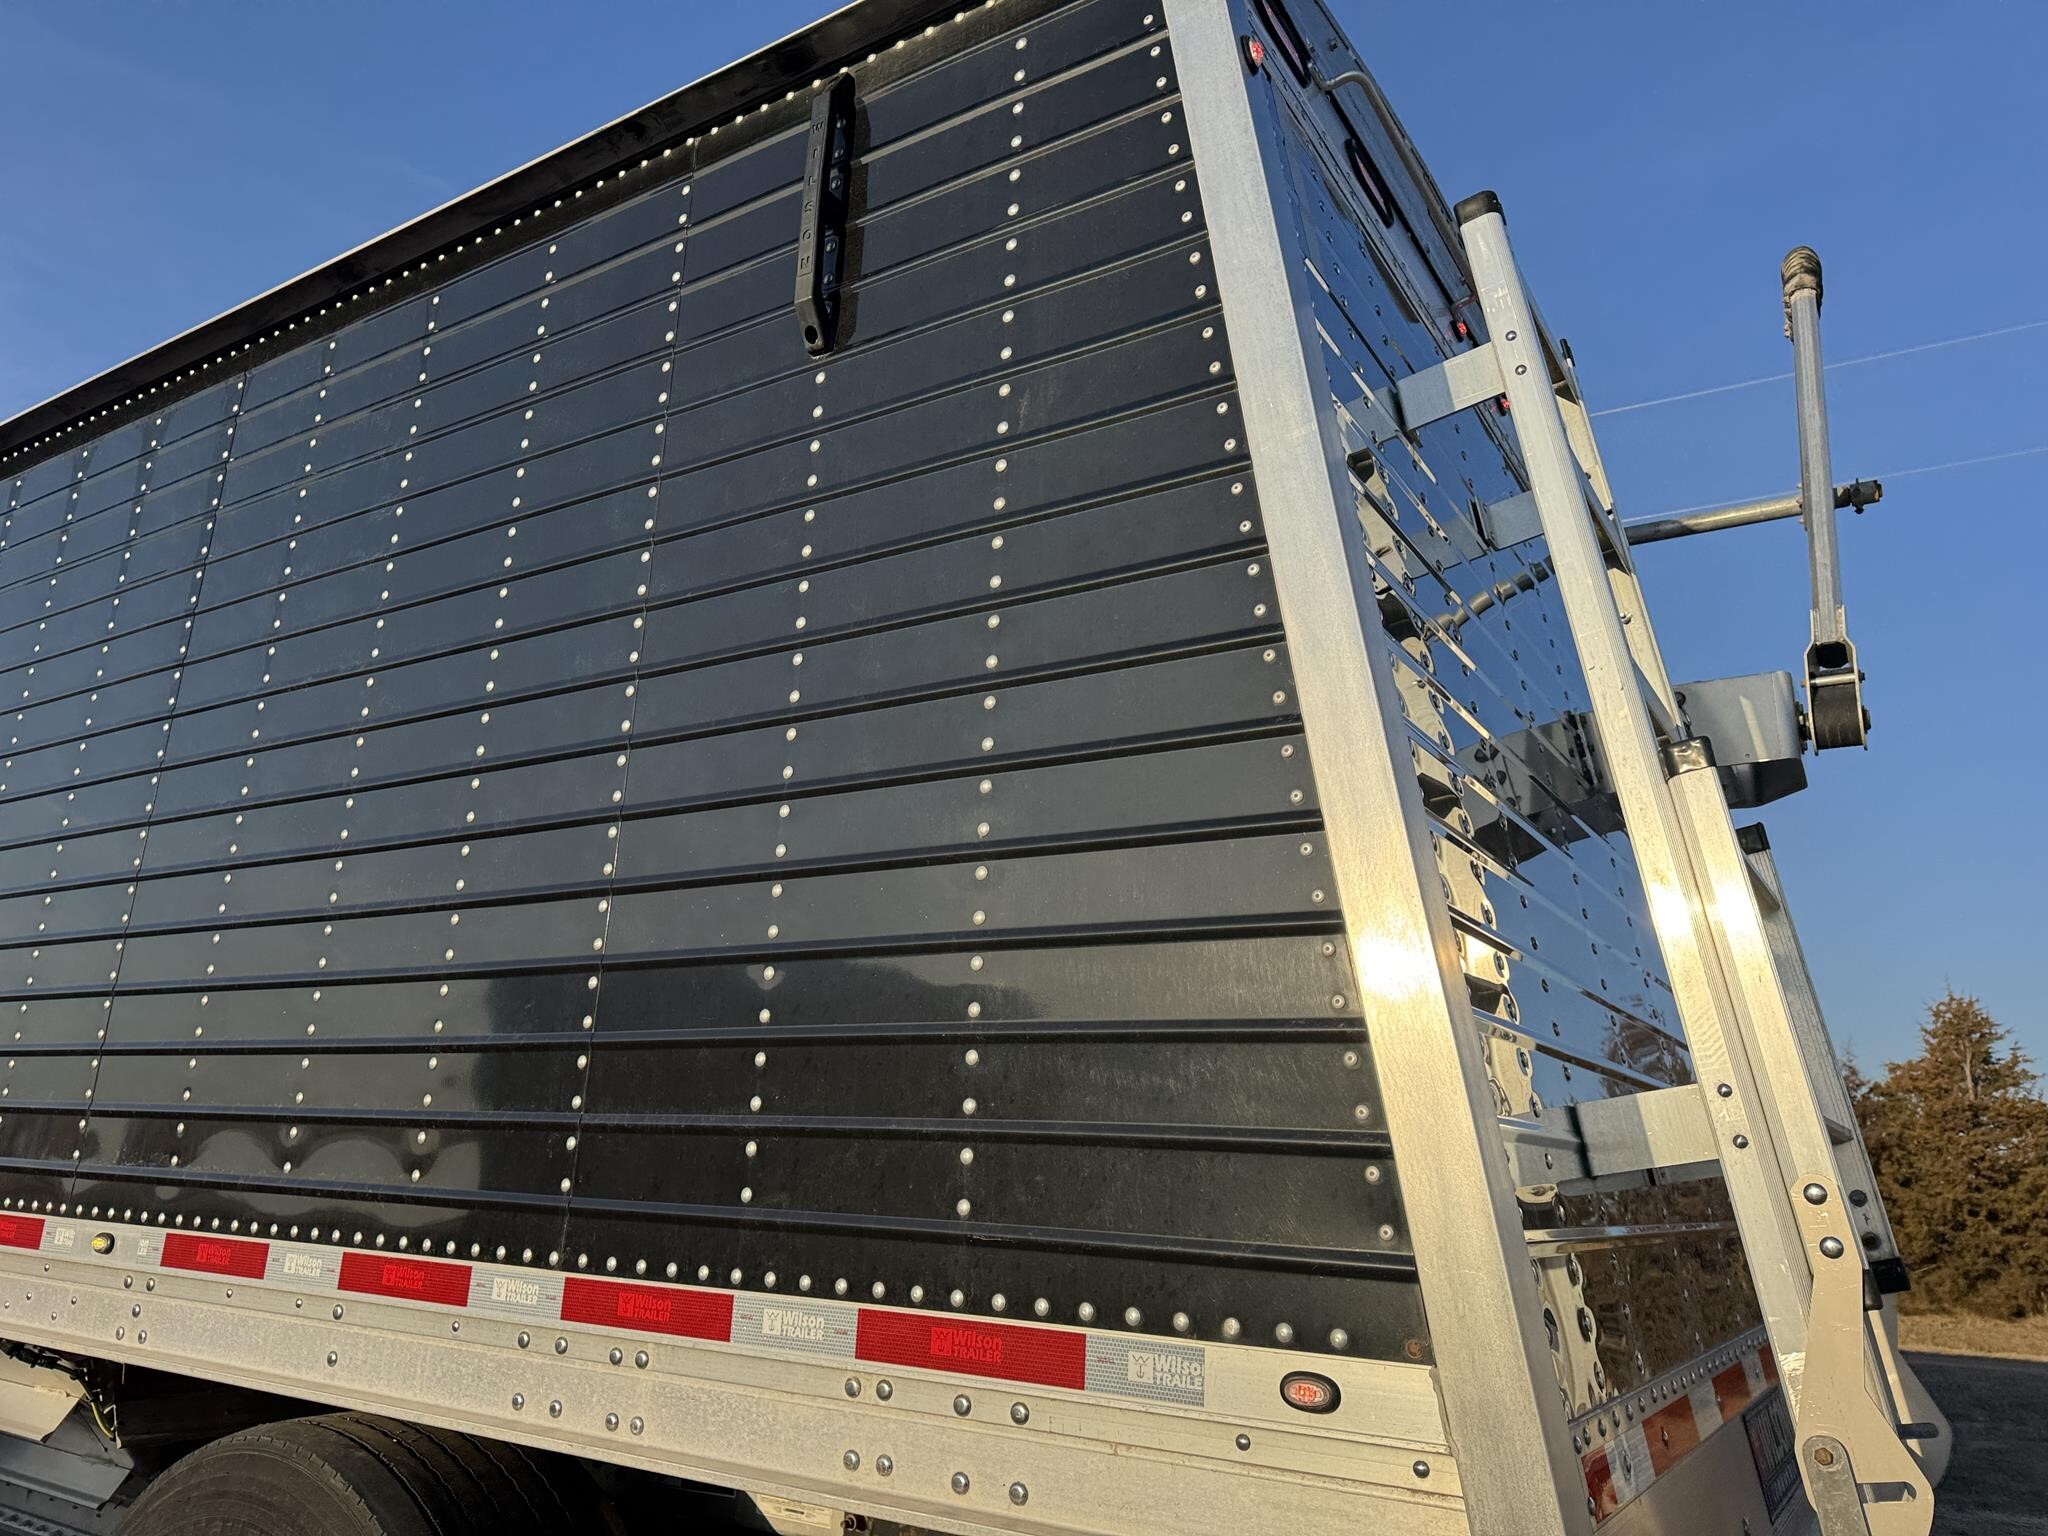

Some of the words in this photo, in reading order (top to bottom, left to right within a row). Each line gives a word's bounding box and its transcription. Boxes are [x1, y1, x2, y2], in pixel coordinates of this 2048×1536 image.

[800, 120, 826, 270] WILSON
[507, 1279, 539, 1296] Wilson
[506, 1292, 538, 1305] TRAILER
[635, 1294, 672, 1312] Wilson
[634, 1307, 671, 1322] TRAILER
[782, 1310, 825, 1329] Wilson
[782, 1326, 825, 1341] TRAILER
[953, 1330, 1003, 1351] Wilson
[953, 1345, 1002, 1363] TRAILER
[1154, 1354, 1205, 1377] Wilso
[1155, 1371, 1204, 1390] TRAILE
